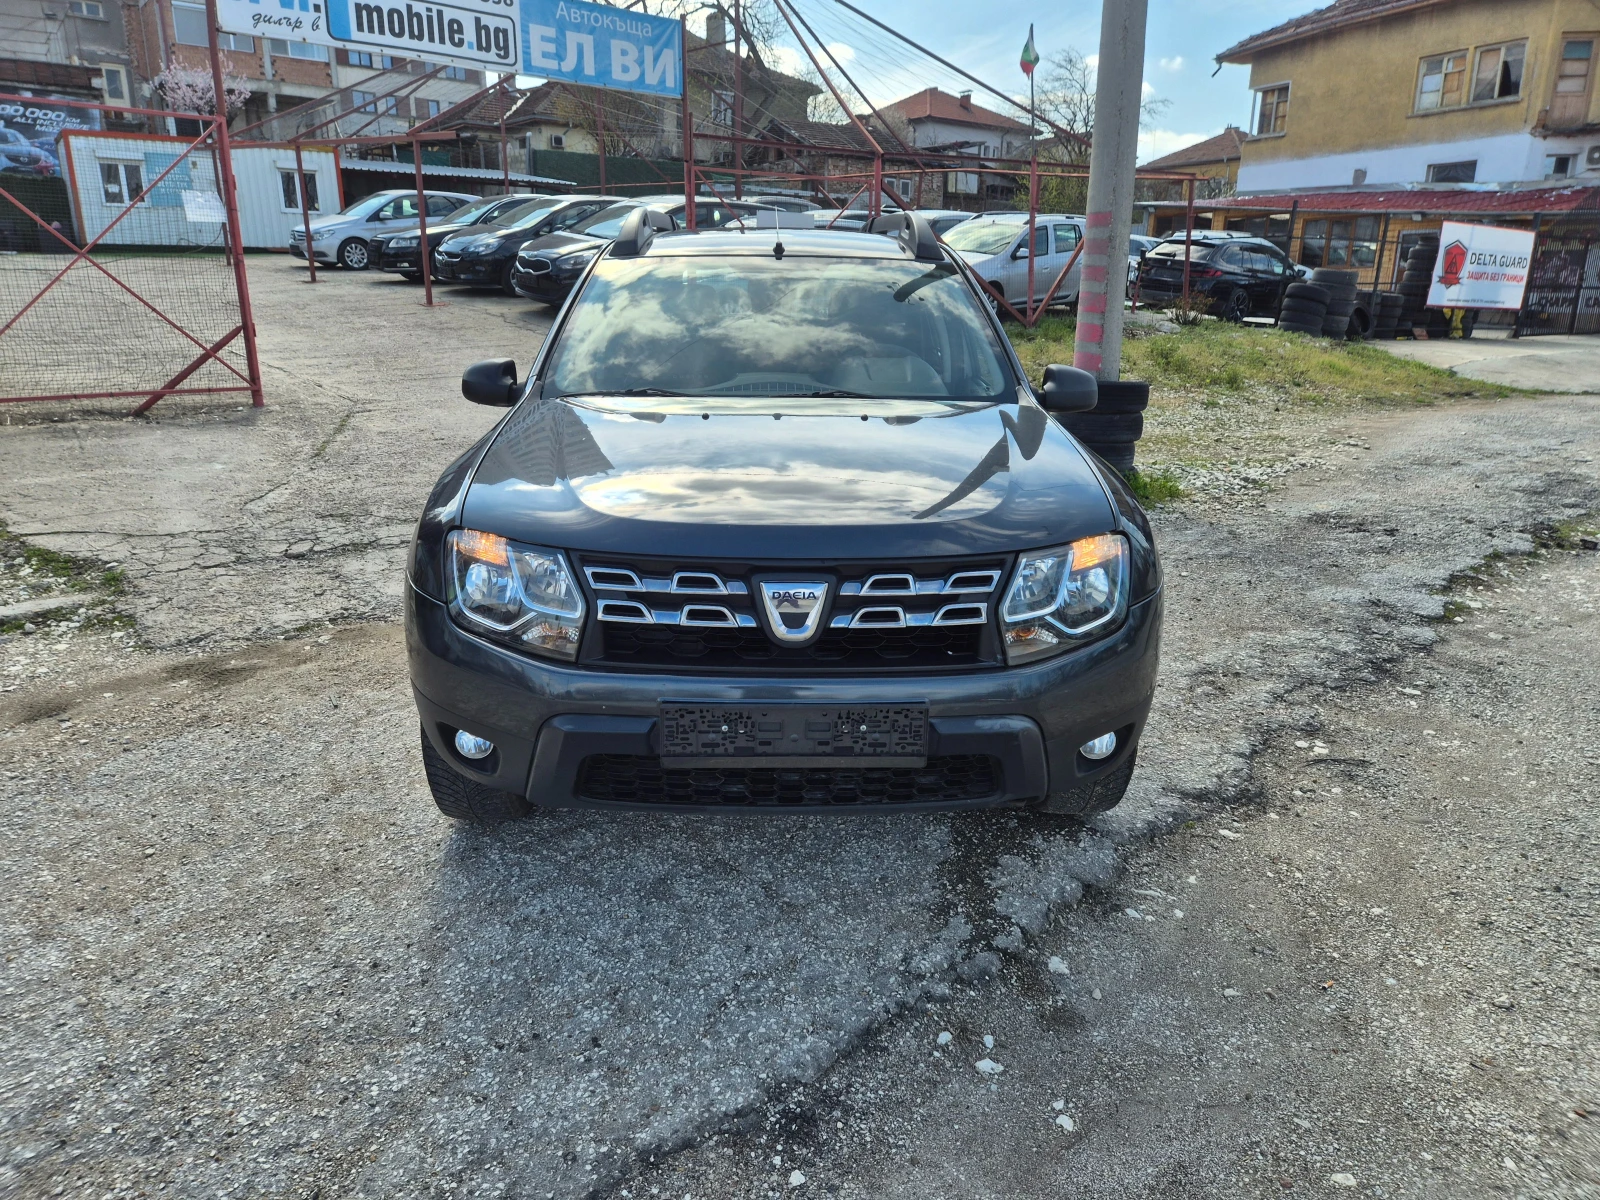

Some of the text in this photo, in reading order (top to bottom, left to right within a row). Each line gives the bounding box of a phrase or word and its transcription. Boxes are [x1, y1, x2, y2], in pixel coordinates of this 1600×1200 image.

[251, 12, 304, 32] дилър
[555, 1, 652, 38] Автокъща
[354, 2, 510, 60] mobile.bg
[528, 23, 675, 88] ЕЛ ВИ
[25, 107, 66, 121] 000
[12, 116, 35, 124] ALL
[36, 118, 91, 131] INCLUSIVE
[1469, 252, 1528, 269] DELTA GUARD
[1466, 270, 1525, 285] ЗАЩИТА БЕЗ ГРАНИЦИ
[772, 591, 817, 600] DACIA
